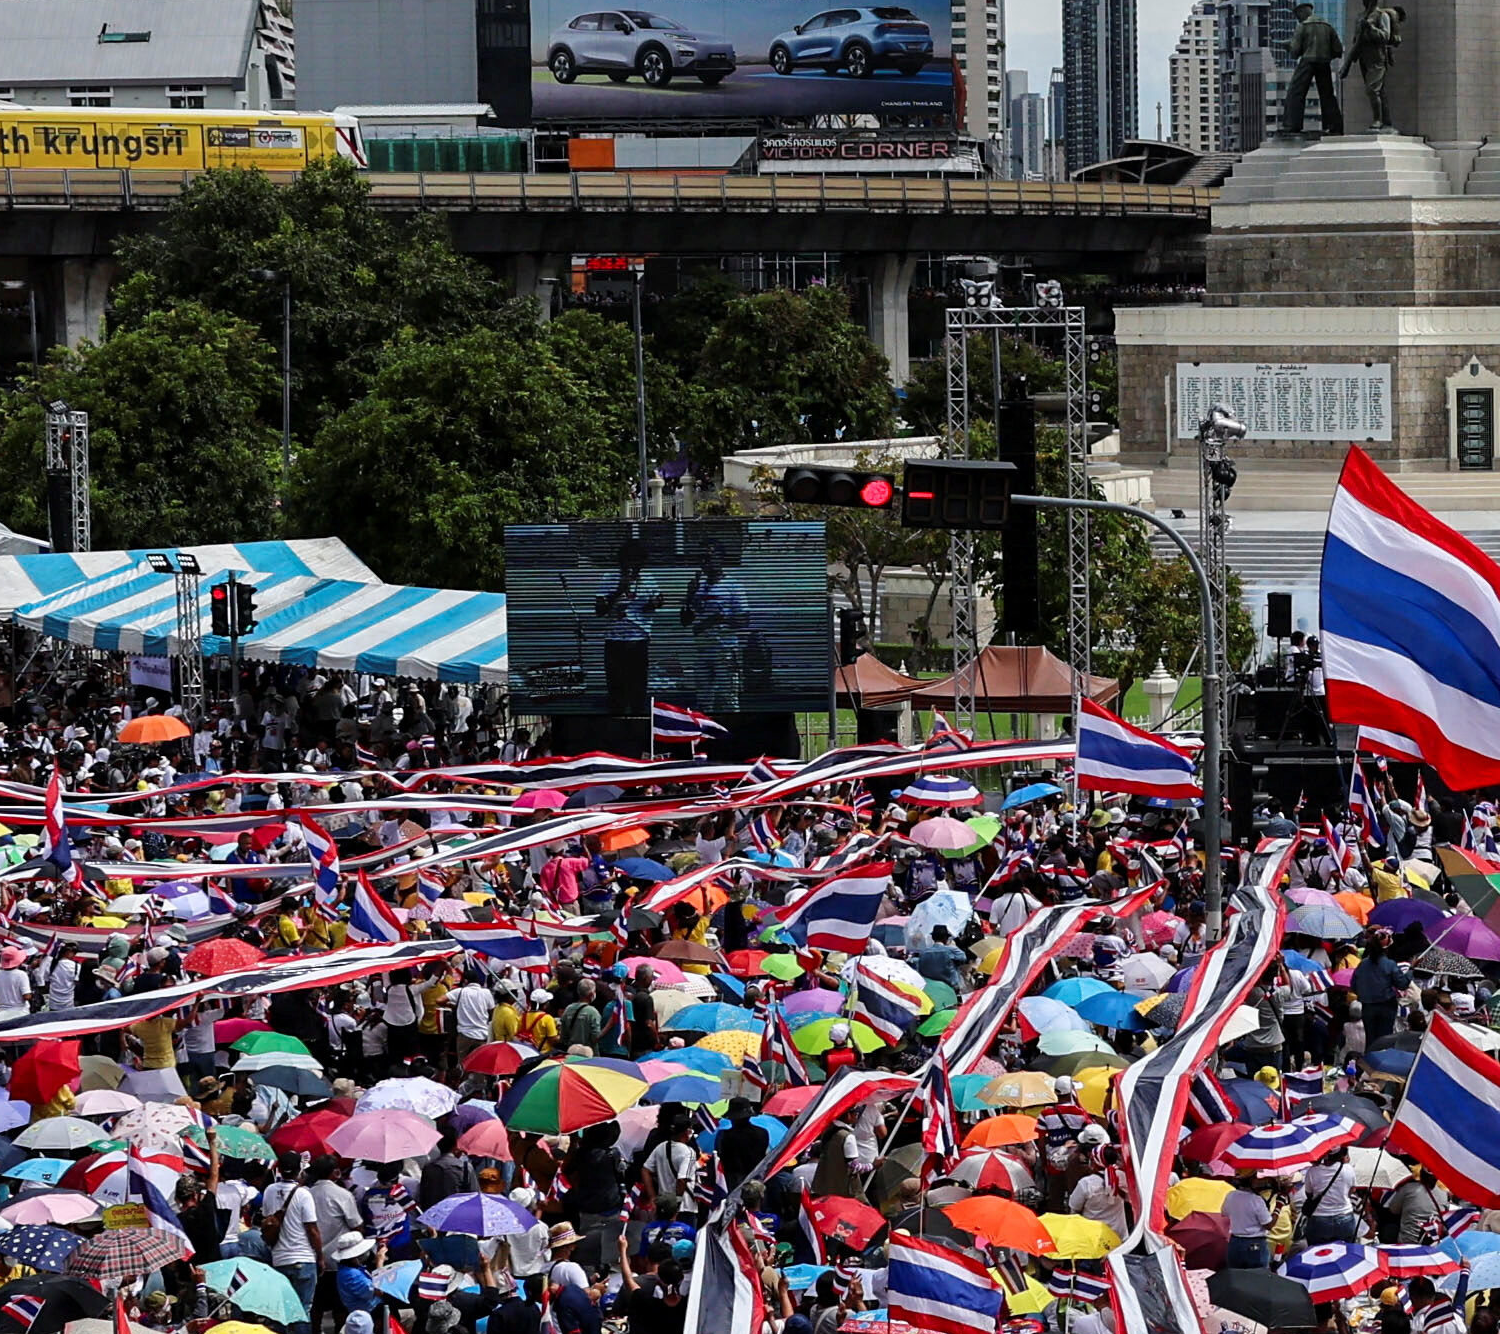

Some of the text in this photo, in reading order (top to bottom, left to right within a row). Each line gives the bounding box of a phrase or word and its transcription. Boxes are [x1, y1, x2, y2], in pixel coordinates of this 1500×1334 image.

[44, 126, 183, 161] krungsri
[762, 142, 950, 159] VICTORY CORNER
[1212, 928, 1220, 940] 7
